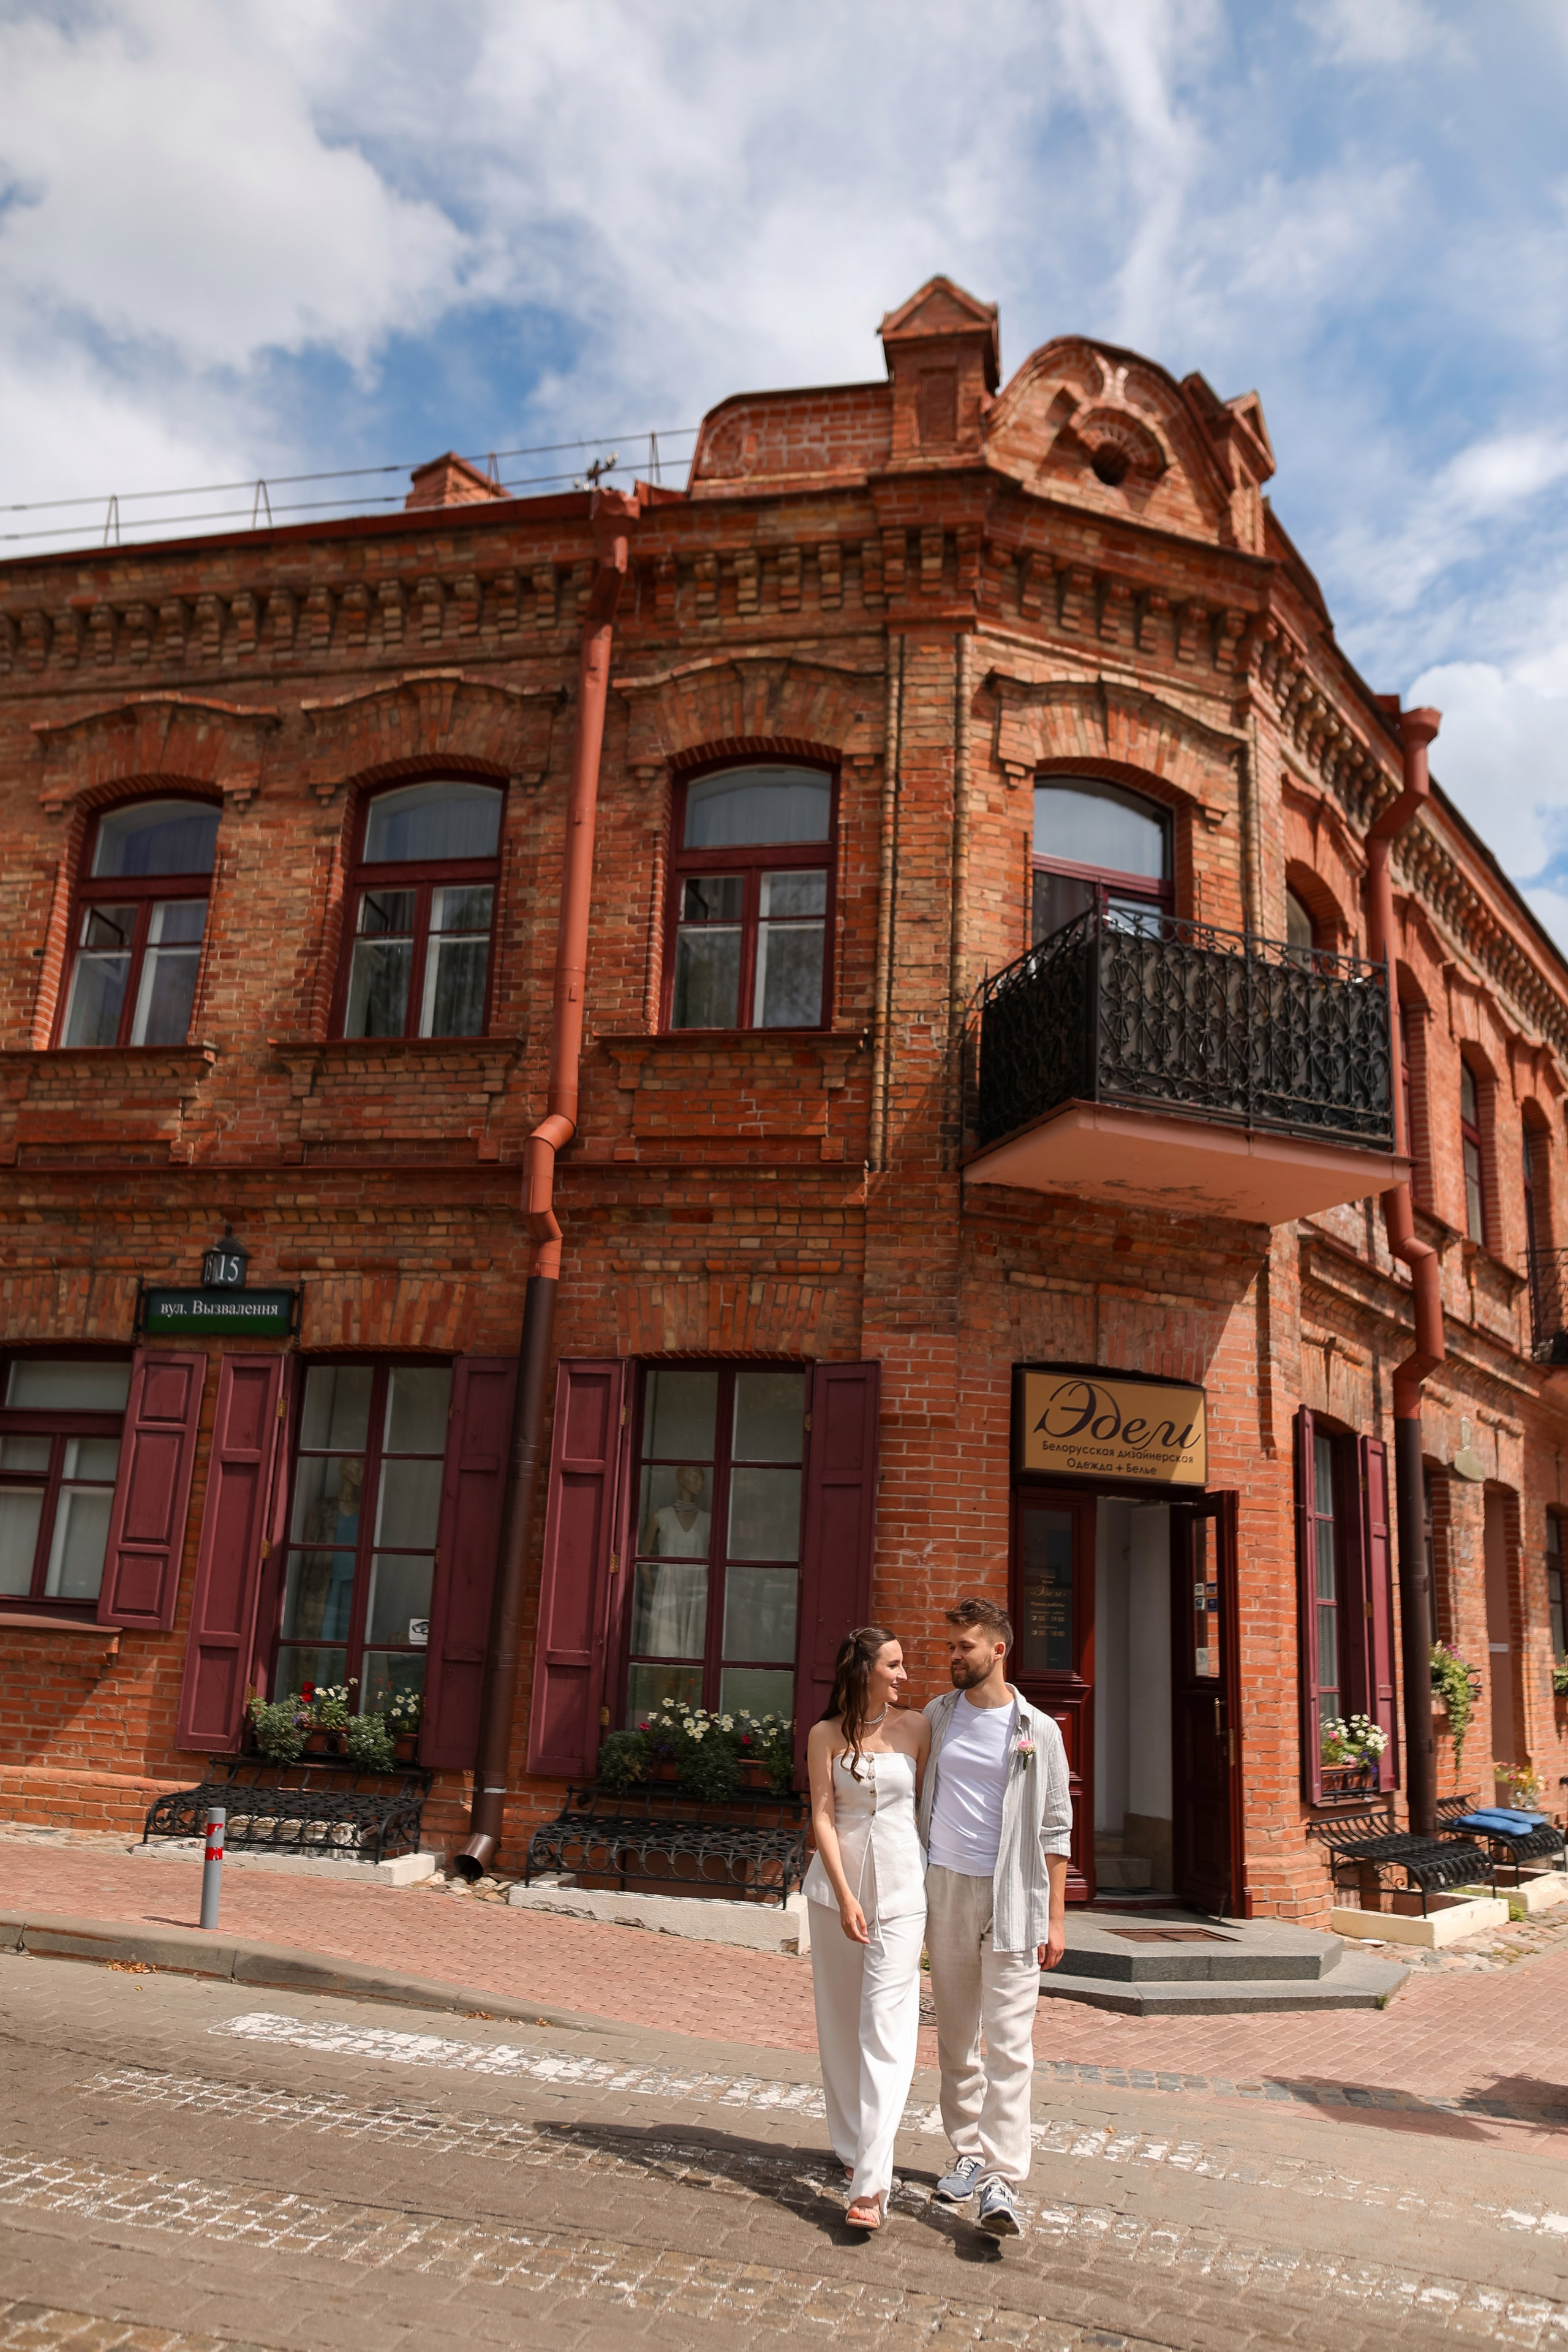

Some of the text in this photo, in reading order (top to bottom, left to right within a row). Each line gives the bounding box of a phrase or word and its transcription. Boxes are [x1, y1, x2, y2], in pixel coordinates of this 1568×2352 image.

[218, 1254, 239, 1282] 15
[160, 1300, 278, 1317] вул. Вызвалення
[1042, 1440, 1194, 1464] Белорусская дизайнерская
[1067, 1458, 1157, 1475] Одежда + Белье
